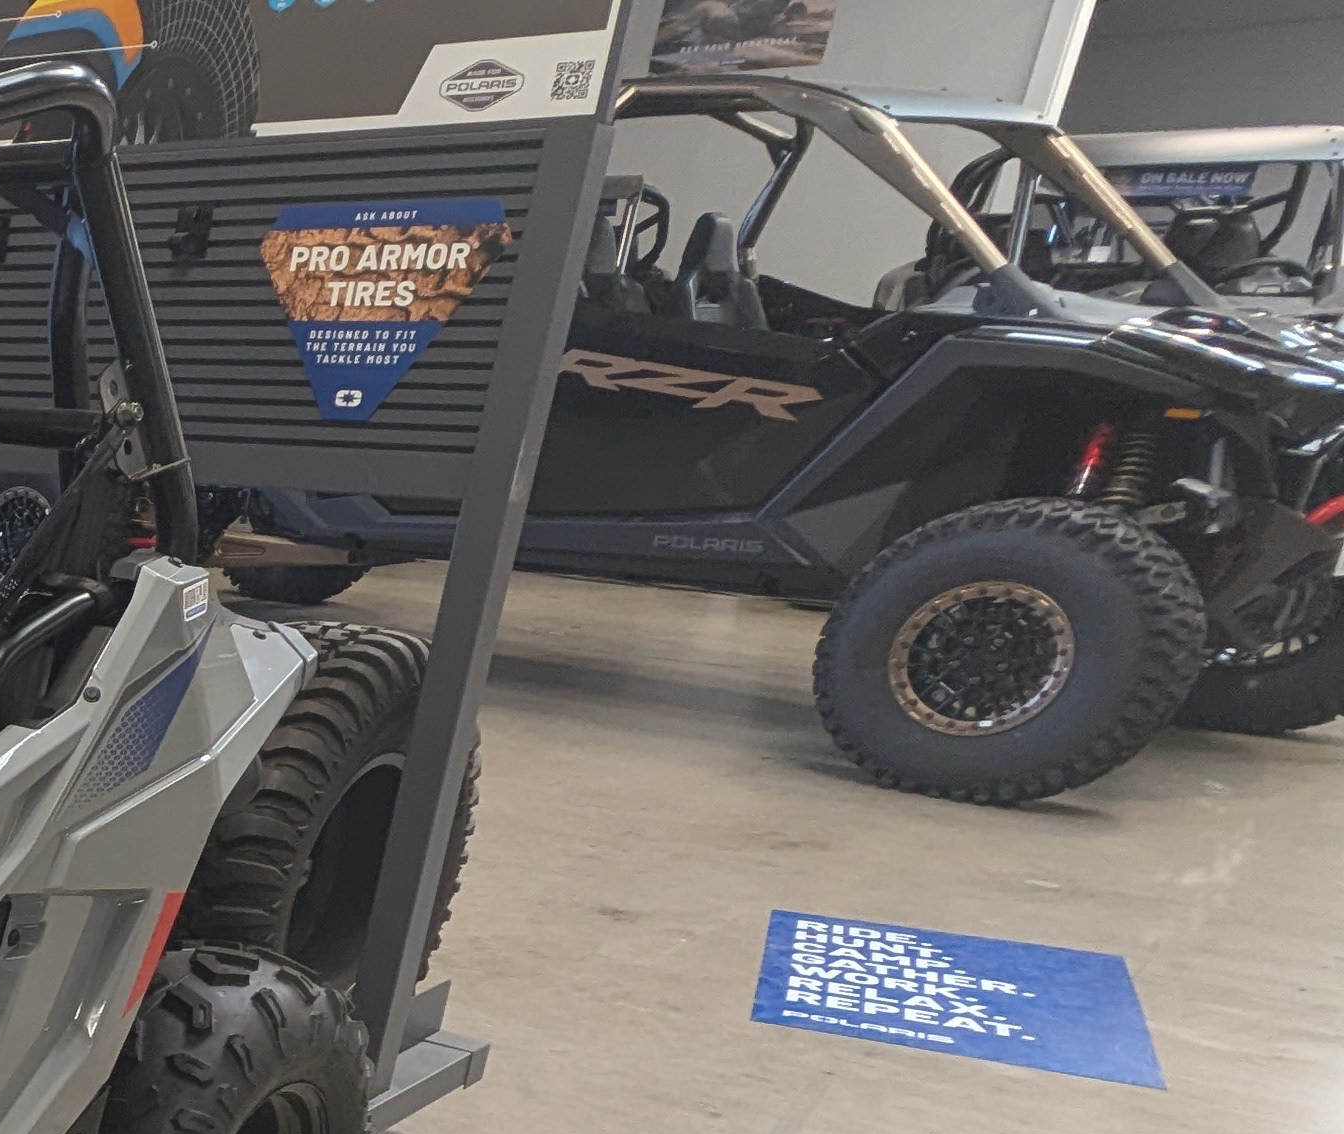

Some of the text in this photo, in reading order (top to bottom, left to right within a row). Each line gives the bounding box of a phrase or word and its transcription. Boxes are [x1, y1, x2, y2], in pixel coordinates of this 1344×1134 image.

[445, 78, 517, 93] POLARIS
[354, 210, 418, 222] ASK ABOUT
[289, 245, 351, 272] PRO
[327, 280, 417, 307] TIRES
[305, 342, 417, 352] THE TERRAIN YOU
[309, 330, 417, 340] DESIGNED TO FIT
[315, 354, 399, 365] TACKLE MOST
[559, 349, 824, 422] RZR
[653, 535, 764, 552] POLARIS
[794, 931, 953, 960] HUNT.
[796, 919, 932, 947] RIDE.
[792, 942, 965, 974] CAMP.
[790, 963, 978, 1002] WORK.
[791, 953, 1036, 998] GATHER.
[788, 975, 1007, 1021] RELAX.
[782, 1009, 955, 1044] POLARIS
[785, 988, 1036, 1041] REPEAT.
